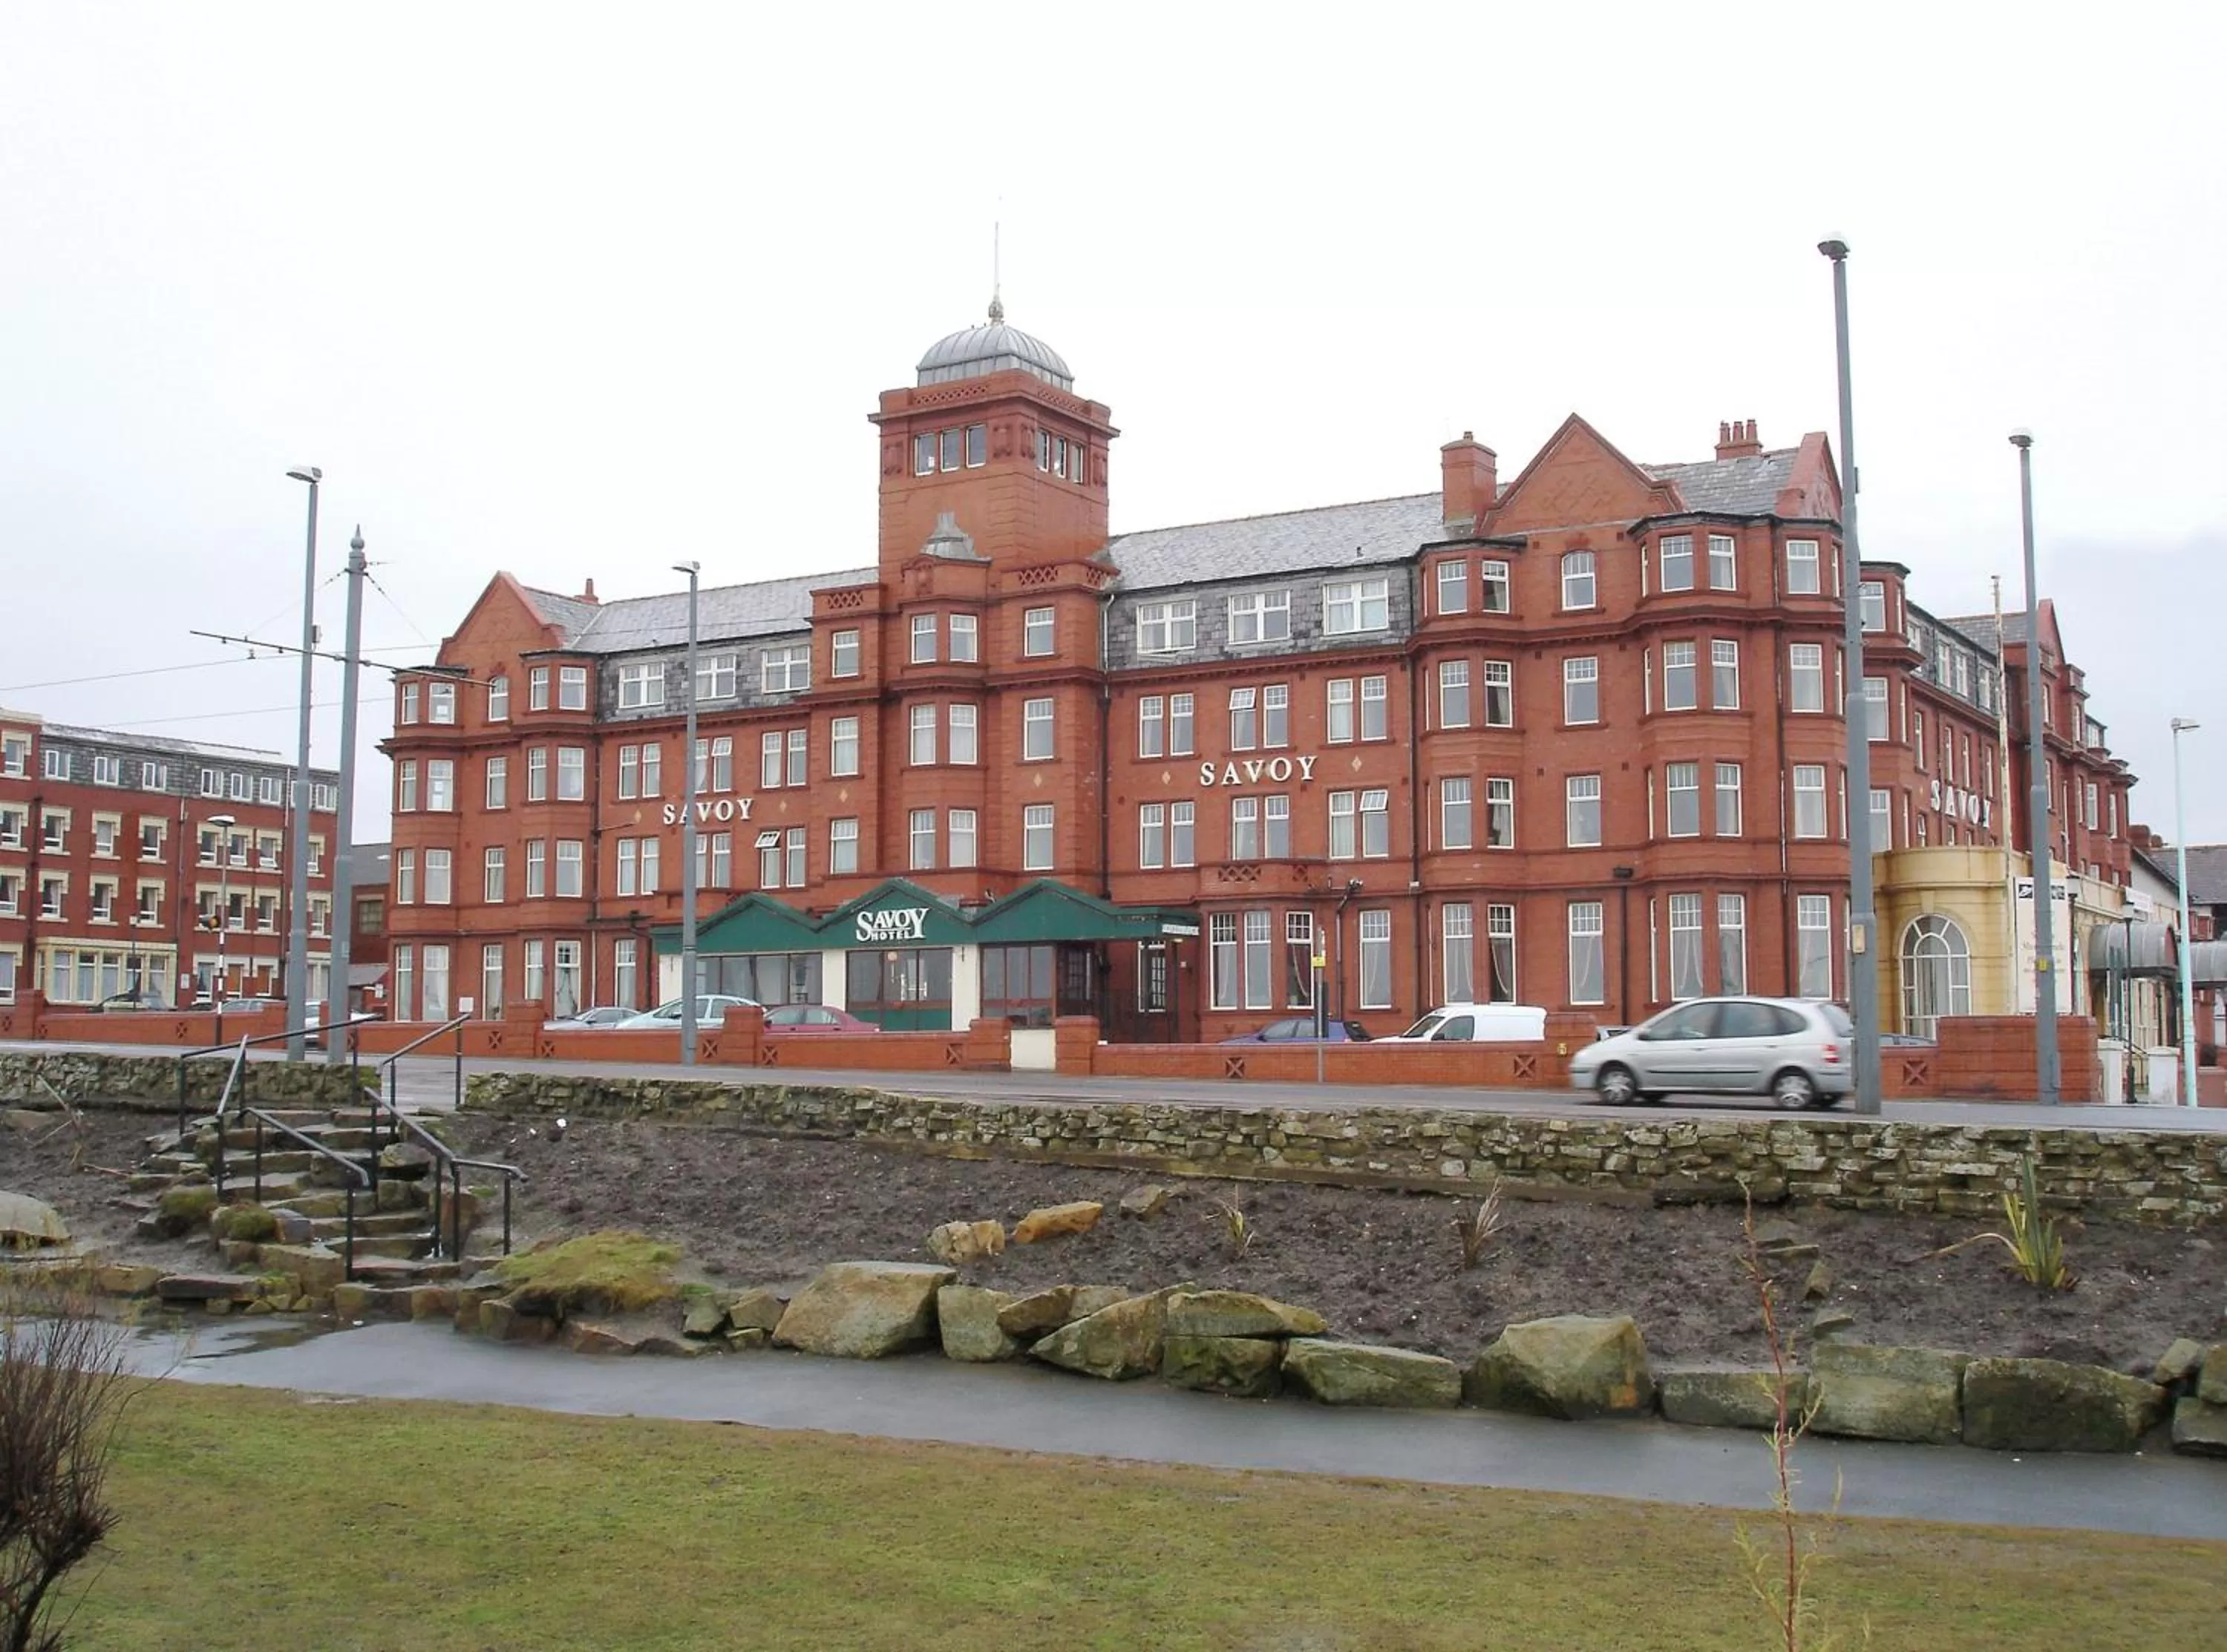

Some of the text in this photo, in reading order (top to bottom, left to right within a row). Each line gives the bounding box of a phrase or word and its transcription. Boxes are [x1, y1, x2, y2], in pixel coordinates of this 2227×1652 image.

[1200, 755, 1318, 786] SAVOY
[1930, 780, 1991, 827] SAVOY
[856, 908, 929, 941] SAVOY
[871, 930, 914, 941] HOTEL
